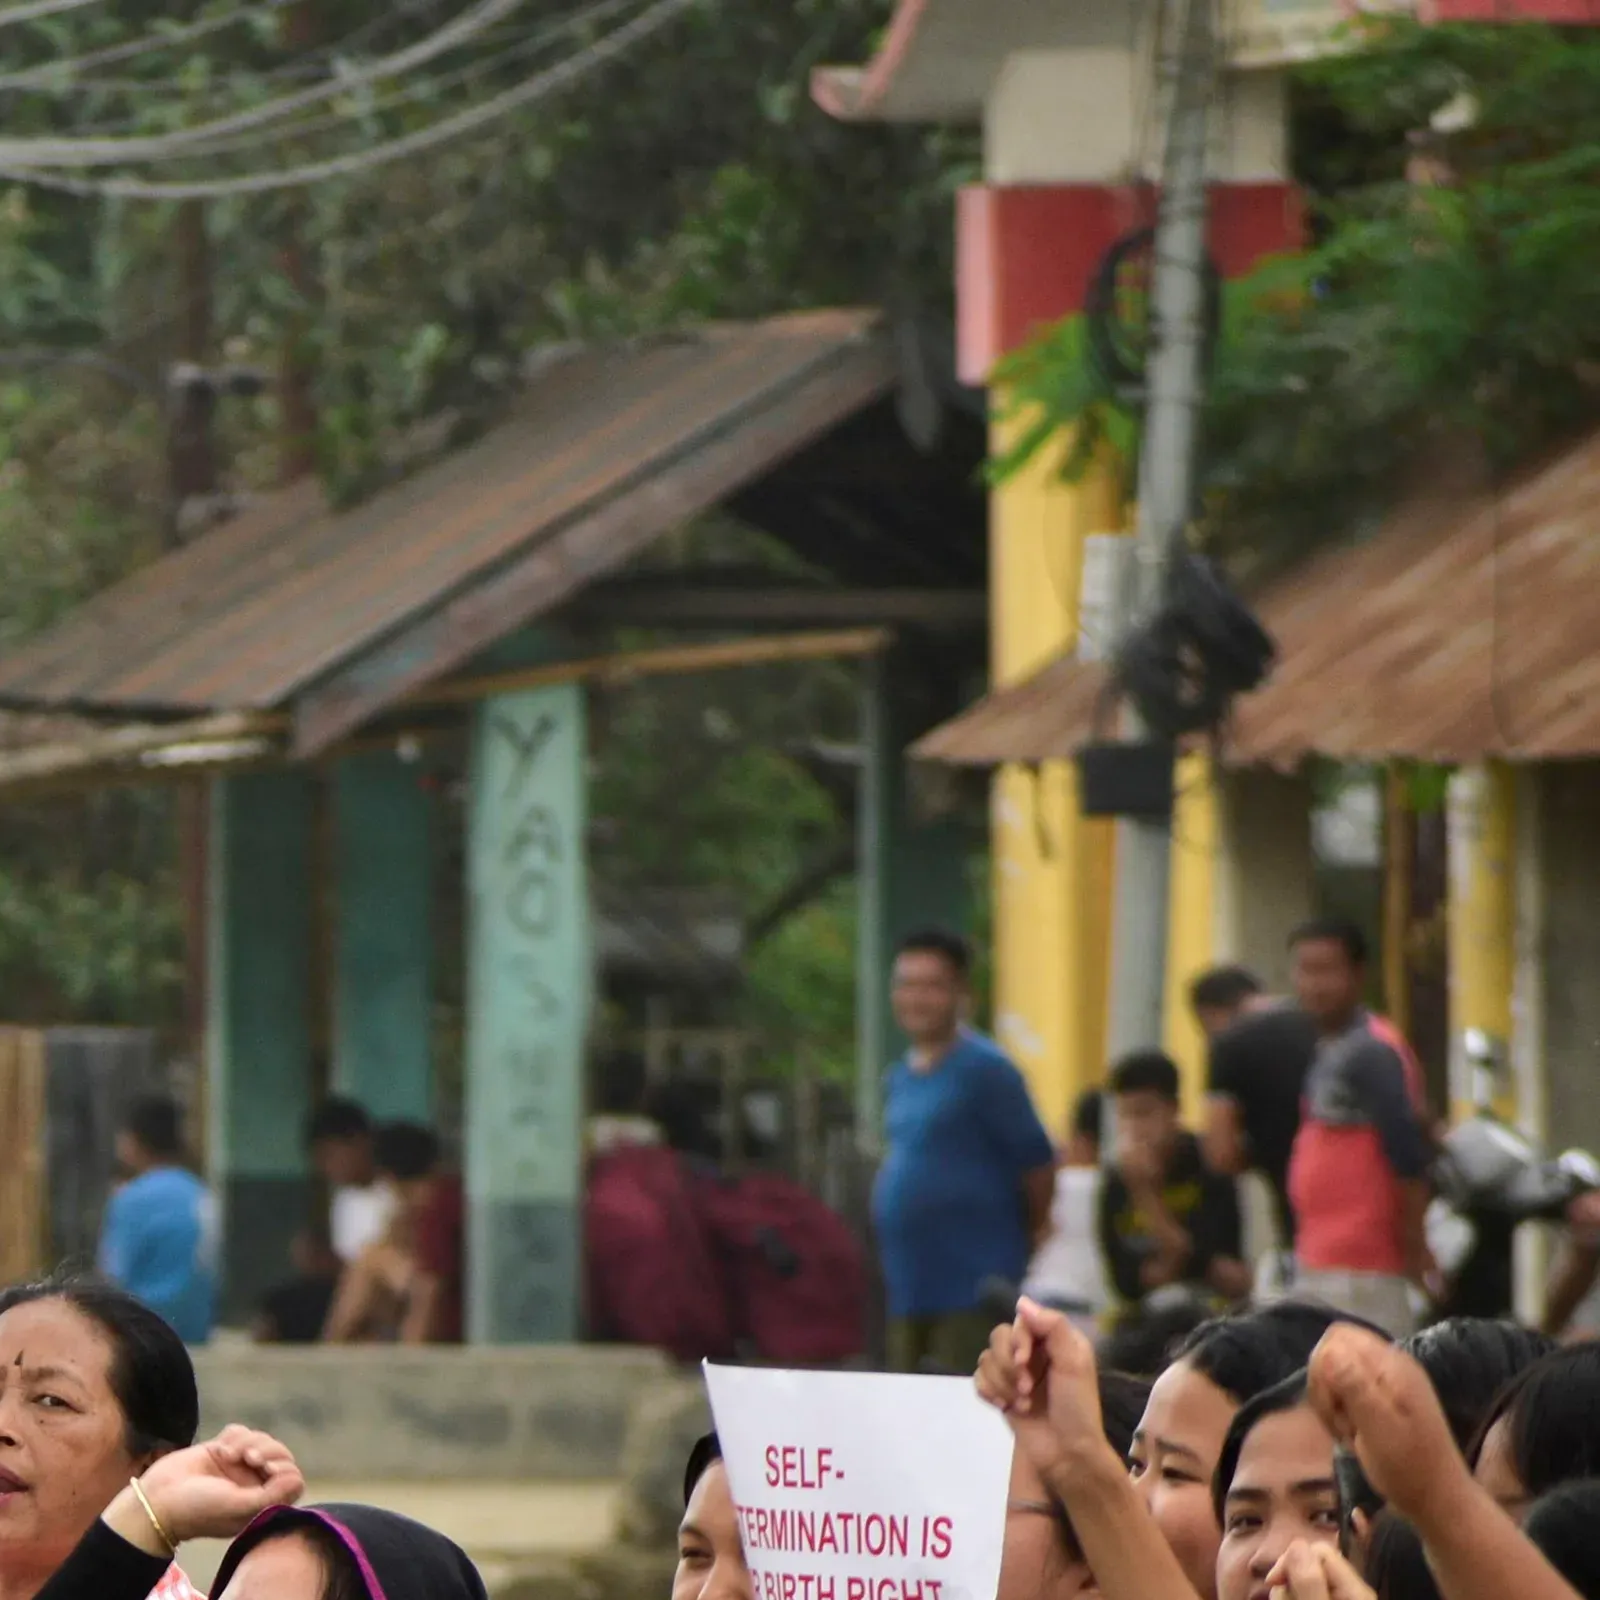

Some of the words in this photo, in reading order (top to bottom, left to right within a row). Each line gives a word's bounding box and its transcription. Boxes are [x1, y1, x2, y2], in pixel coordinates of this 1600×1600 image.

[765, 1444, 845, 1489] SELF-
[736, 1504, 909, 1557] TERMINATION
[921, 1516, 953, 1559] IS
